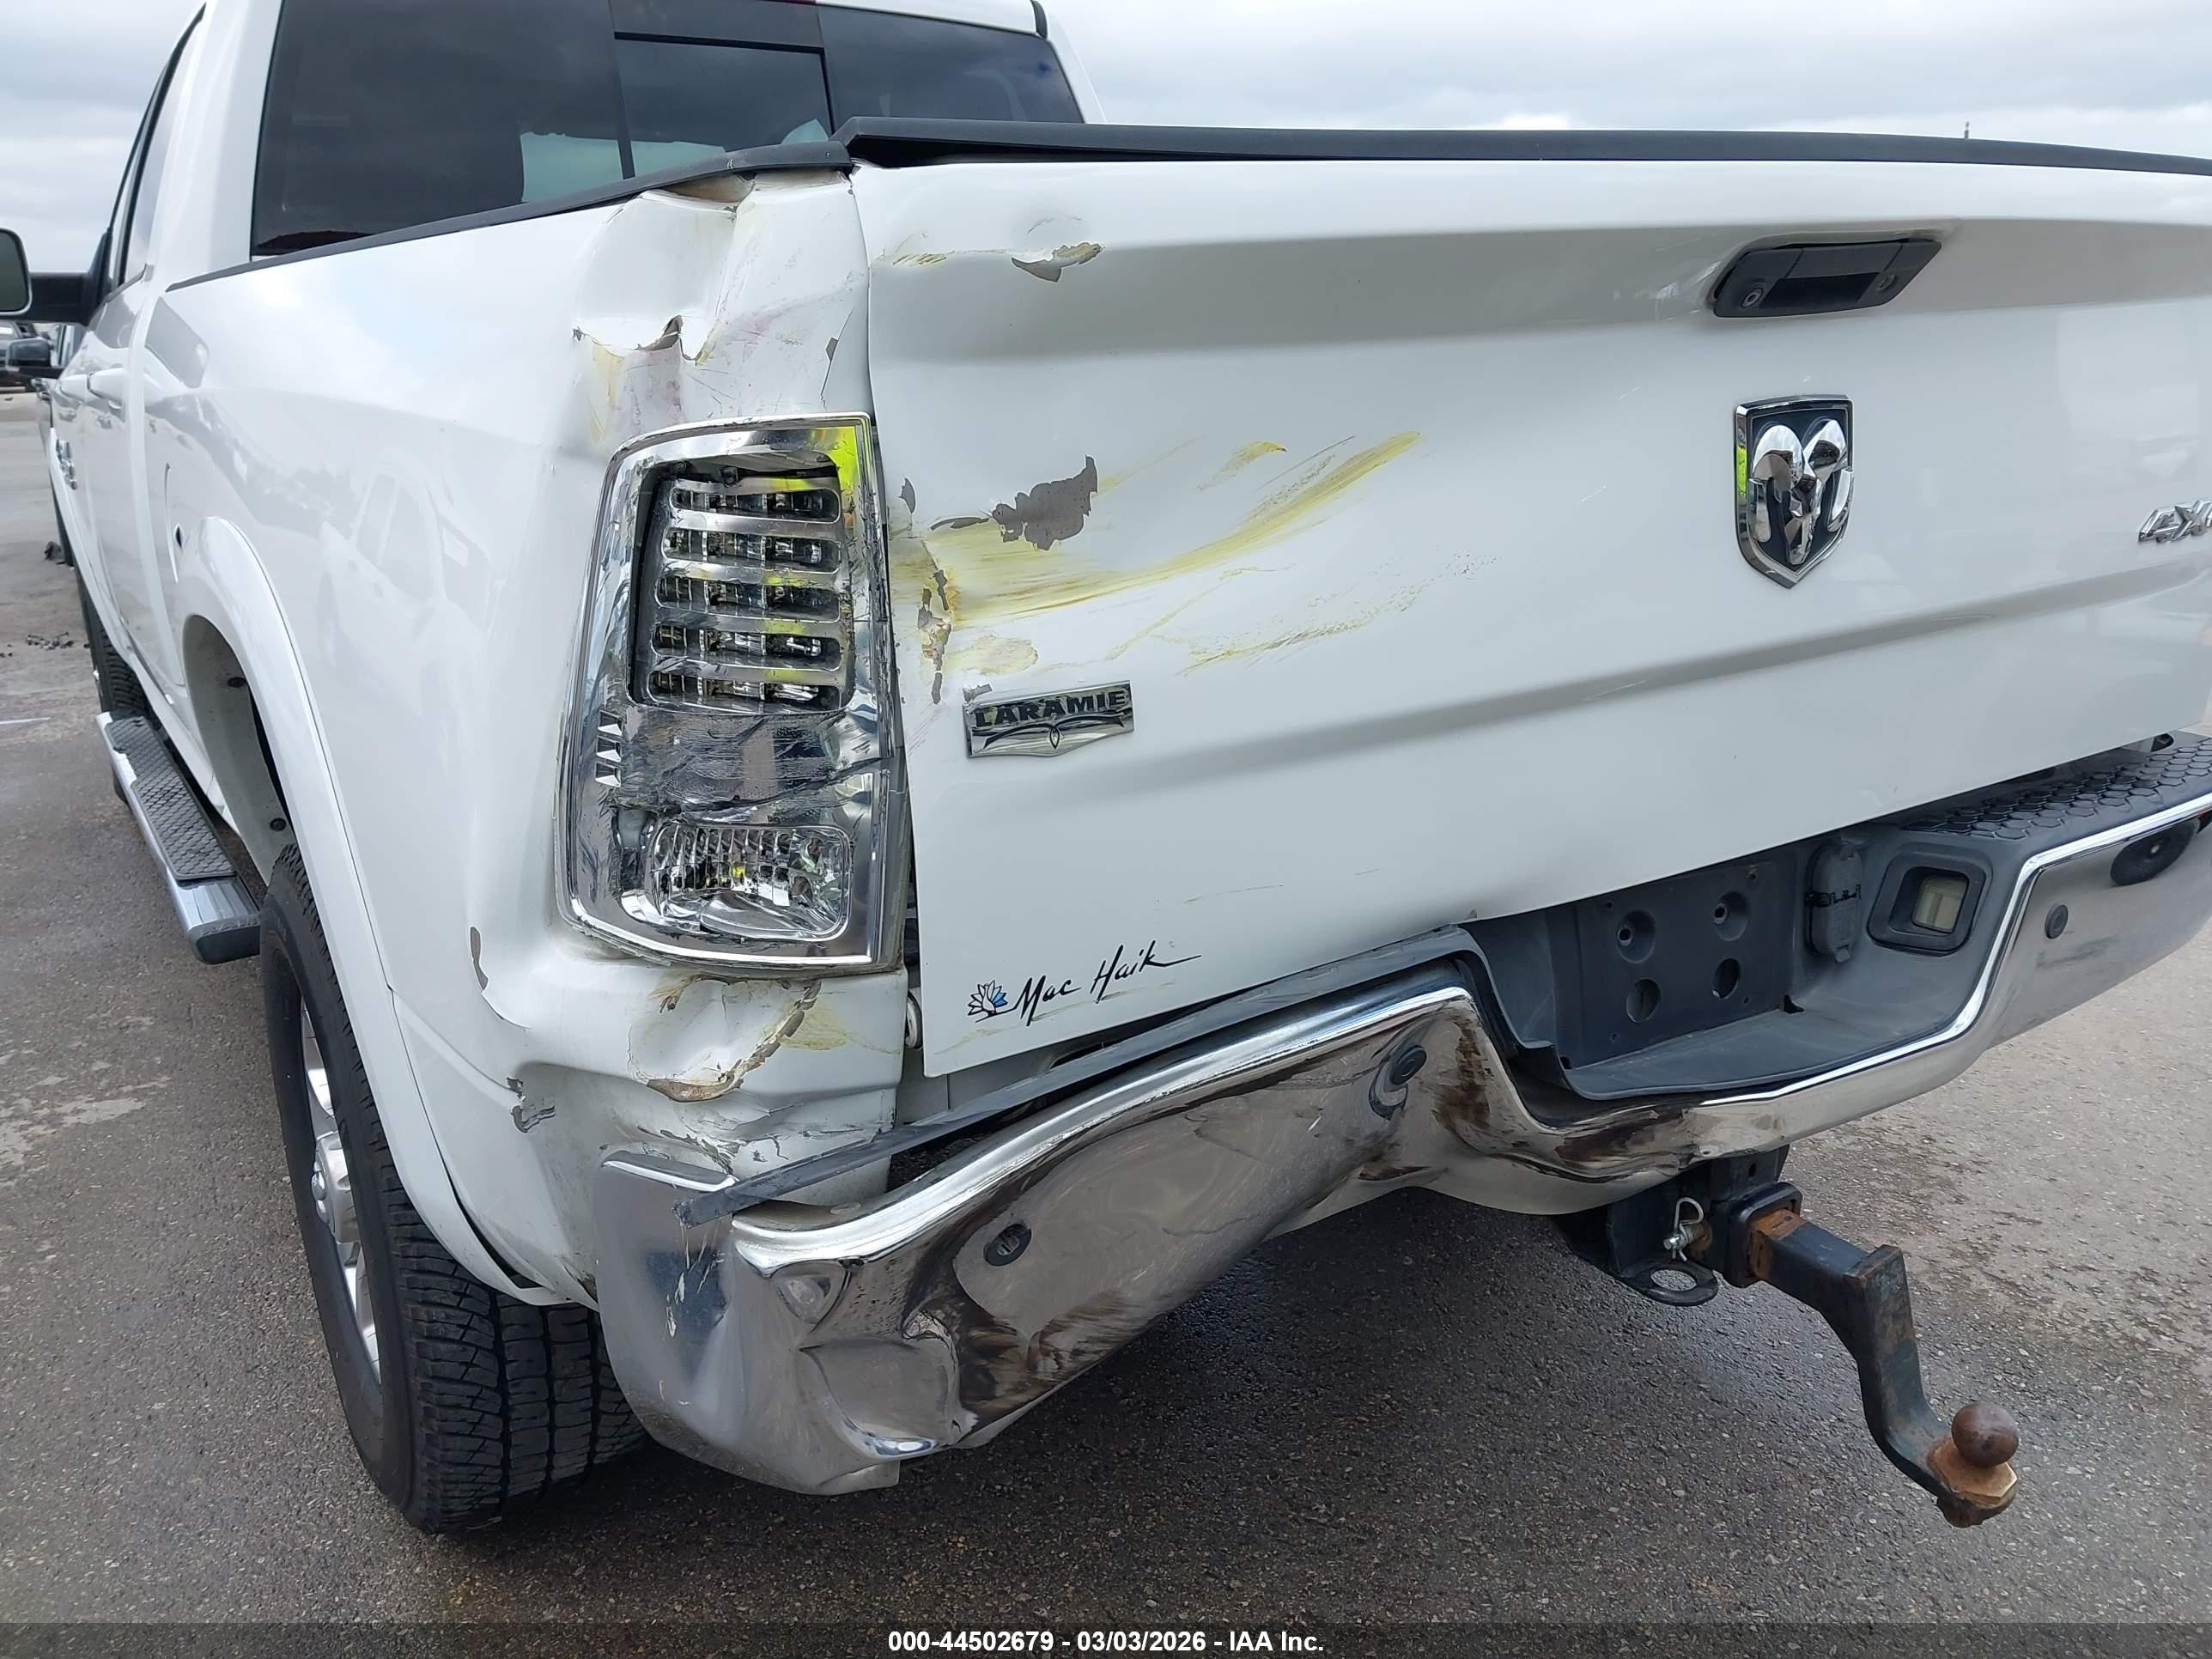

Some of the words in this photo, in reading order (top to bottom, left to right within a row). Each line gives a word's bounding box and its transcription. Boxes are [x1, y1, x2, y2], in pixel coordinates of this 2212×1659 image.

[975, 690, 1129, 727] LARAMIE
[1013, 975, 1081, 1026] Mac
[1090, 939, 1202, 1004] Haik
